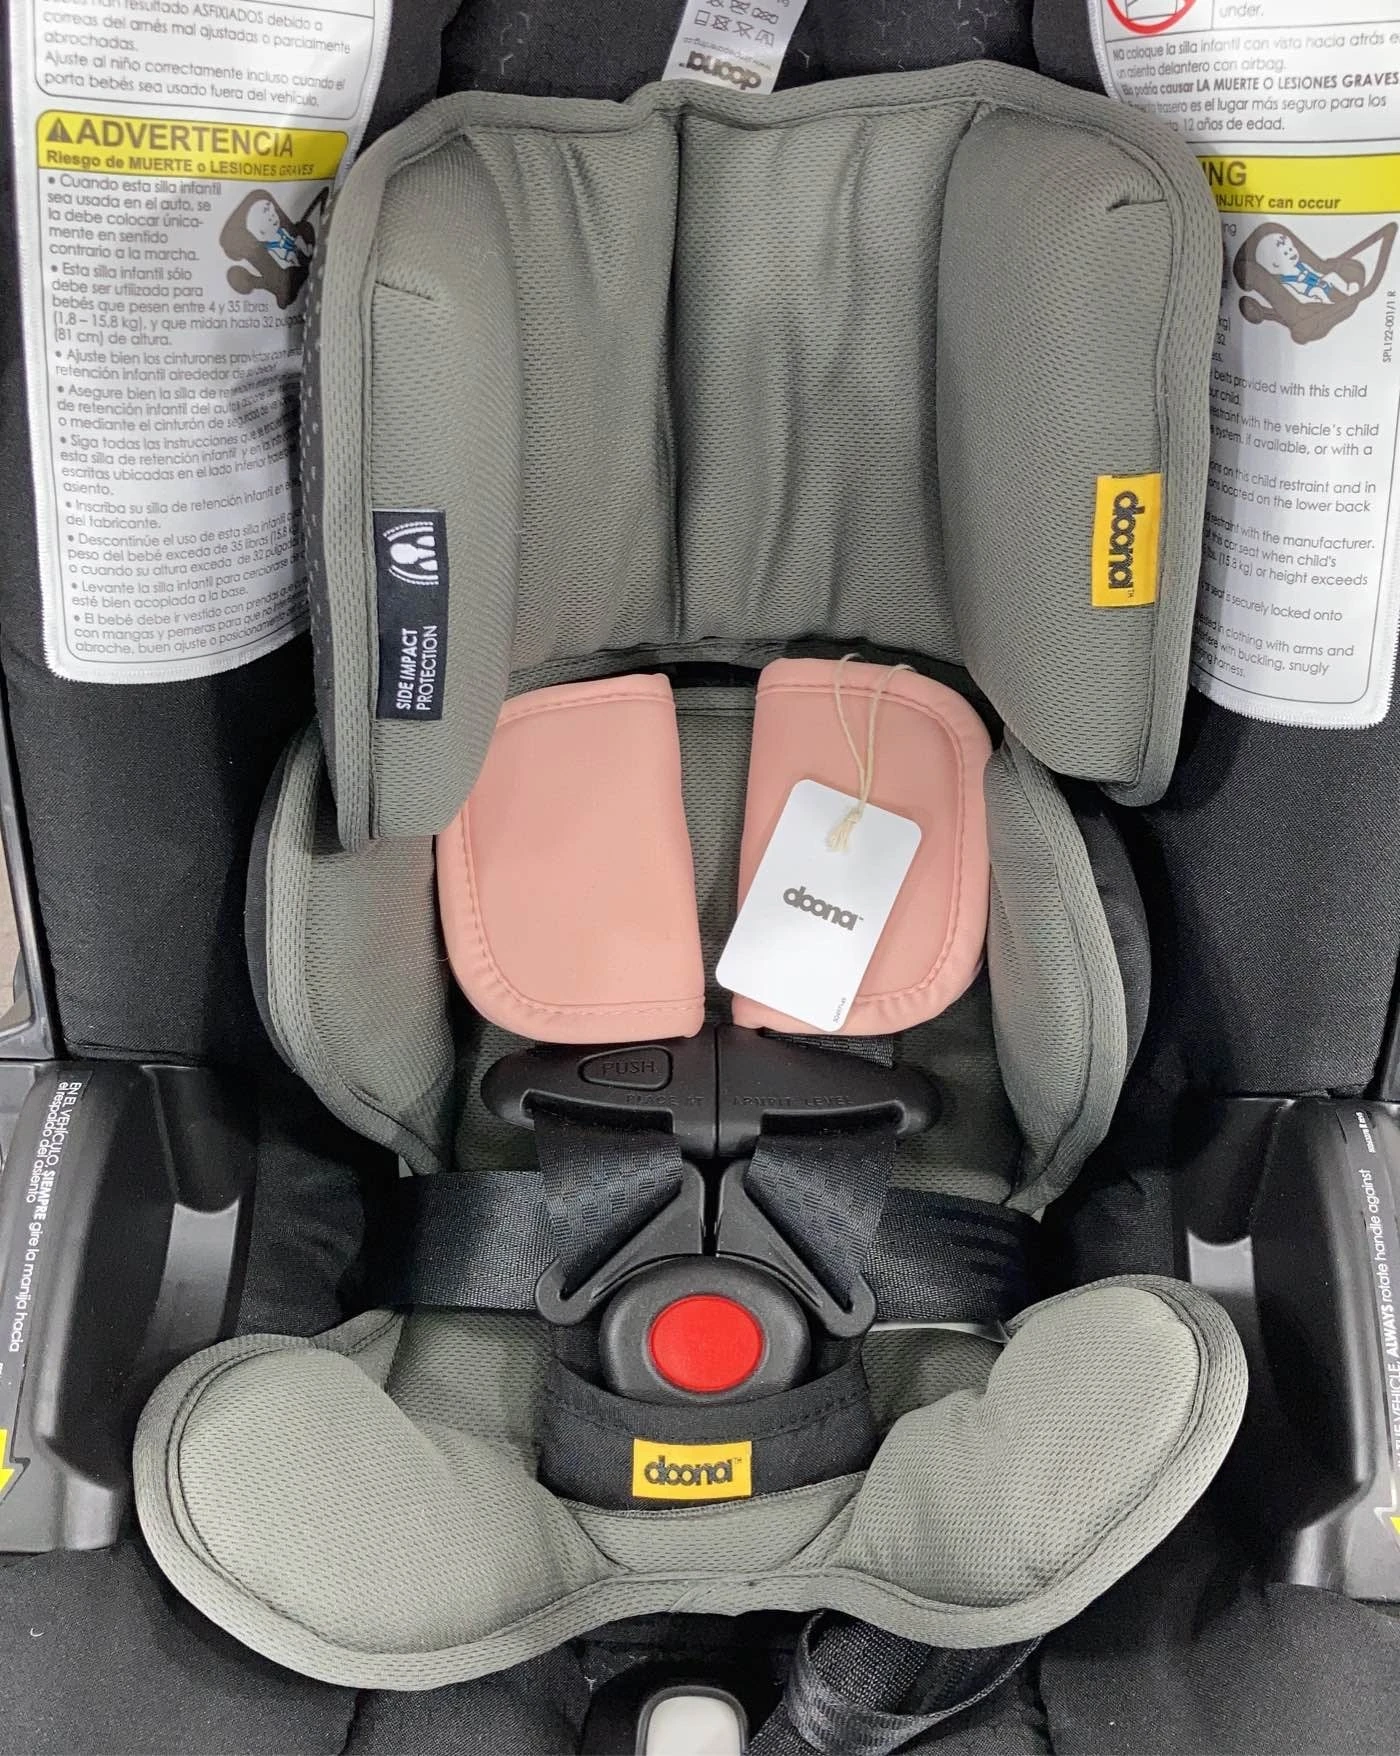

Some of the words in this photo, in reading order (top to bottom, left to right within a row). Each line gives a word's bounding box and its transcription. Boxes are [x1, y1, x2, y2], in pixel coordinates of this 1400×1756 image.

[103, 15, 126, 29] del
[171, 22, 196, 36] mal
[1166, 43, 1176, 55] la
[1179, 41, 1197, 55] silla
[45, 50, 88, 66] Ajuste
[92, 55, 106, 68] al
[110, 55, 141, 72] niño
[144, 61, 243, 80] correctamente
[247, 69, 288, 84] incluso
[1158, 60, 1209, 76] delantero
[45, 72, 84, 87] porta
[138, 81, 162, 93] sea
[166, 80, 207, 96] usado
[211, 83, 243, 99] fuera
[247, 88, 267, 101] del
[1160, 82, 1194, 95] causar
[1197, 79, 1210, 92] LA
[1213, 77, 1259, 91] MUERTE
[1263, 77, 1274, 90] O
[1279, 75, 1338, 90] LESIONES
[1342, 72, 1399, 88] GRAVES
[1190, 102, 1202, 112] es
[1204, 98, 1215, 111] el
[1217, 98, 1248, 113] lugar
[1252, 96, 1278, 111] más
[1282, 99, 1326, 113] seguro
[1330, 96, 1364, 112] para
[1368, 93, 1387, 108] los
[1184, 118, 1194, 131] 12
[1198, 117, 1223, 131] años
[1226, 118, 1242, 130] de
[1246, 117, 1285, 131] edad.
[76, 118, 293, 158] ADVERTENCIA
[47, 150, 101, 169] Riesgo
[105, 155, 125, 169] de
[129, 157, 192, 172] MUERTE
[197, 162, 206, 172] o
[210, 161, 277, 176] LESIONES
[60, 173, 119, 191] Cuando
[122, 179, 151, 193] esta
[155, 180, 177, 193] silla
[180, 181, 222, 195] infantil
[48, 191, 72, 205] sea
[76, 193, 120, 208] usada
[124, 198, 141, 209] en
[145, 198, 157, 210] el
[197, 201, 212, 212] se
[1268, 198, 1293, 209] can
[1298, 198, 1341, 209] occur
[49, 207, 60, 220] la
[65, 208, 103, 223] debe
[107, 213, 160, 225] colocar
[49, 226, 94, 240] mente
[98, 230, 116, 241] en
[120, 231, 168, 244] sentido
[50, 243, 111, 257] contrario
[115, 247, 125, 258] a
[128, 246, 142, 259] la
[108, 332, 127, 345] de
[68, 384, 122, 401] Asegure
[127, 387, 156, 400] bien
[174, 387, 196, 399] silla
[1280, 382, 1305, 395] with
[1309, 384, 1330, 397] this
[1334, 384, 1368, 398] child
[1264, 419, 1281, 432] the
[1345, 423, 1379, 436] child
[1314, 445, 1327, 455] or
[1331, 443, 1359, 455] with
[1363, 446, 1373, 455] a
[1251, 474, 1277, 488] child
[1279, 478, 1330, 493] restraint
[1333, 481, 1360, 494] and
[1365, 481, 1376, 493] in
[1257, 493, 1270, 505] on
[1274, 496, 1292, 509] the
[1296, 497, 1332, 512] lower
[1335, 500, 1371, 513] back
[1262, 531, 1280, 543] the
[1283, 535, 1375, 550] manufacturer.
[68, 549, 99, 560] peso
[103, 550, 123, 561] del
[1262, 549, 1294, 565] when
[1296, 555, 1336, 567] child's
[1269, 567, 1308, 584] height
[1311, 574, 1368, 586] exceeds
[102, 596, 131, 608] bien
[135, 594, 196, 608] acoplada
[1271, 604, 1311, 620] locked
[1313, 609, 1343, 622] onto
[401, 627, 418, 681] IMPACT
[1266, 638, 1290, 653] with
[1293, 644, 1323, 656] arms
[1327, 645, 1354, 657] and
[416, 625, 438, 711] PROTECTION
[1288, 661, 1330, 676] snugly
[396, 681, 414, 710] SIDE
[602, 1060, 655, 1076] PUSH
[57, 1082, 68, 1091] el
[65, 1081, 82, 1095] EN
[62, 1097, 76, 1107] EL
[42, 1092, 66, 1137] respaldo
[37, 1139, 50, 1157] del
[26, 1160, 44, 1203] asiento
[1359, 1169, 1379, 1213] against
[33, 1169, 56, 1221] SIEMPRE
[28, 1222, 43, 1247] gire
[1370, 1215, 1386, 1260] handle
[25, 1249, 39, 1261] la
[16, 1264, 34, 1309] manija
[1376, 1263, 1392, 1301] rotate
[9, 1312, 28, 1352] hacia
[1381, 1304, 1399, 1358] ALWAYS
